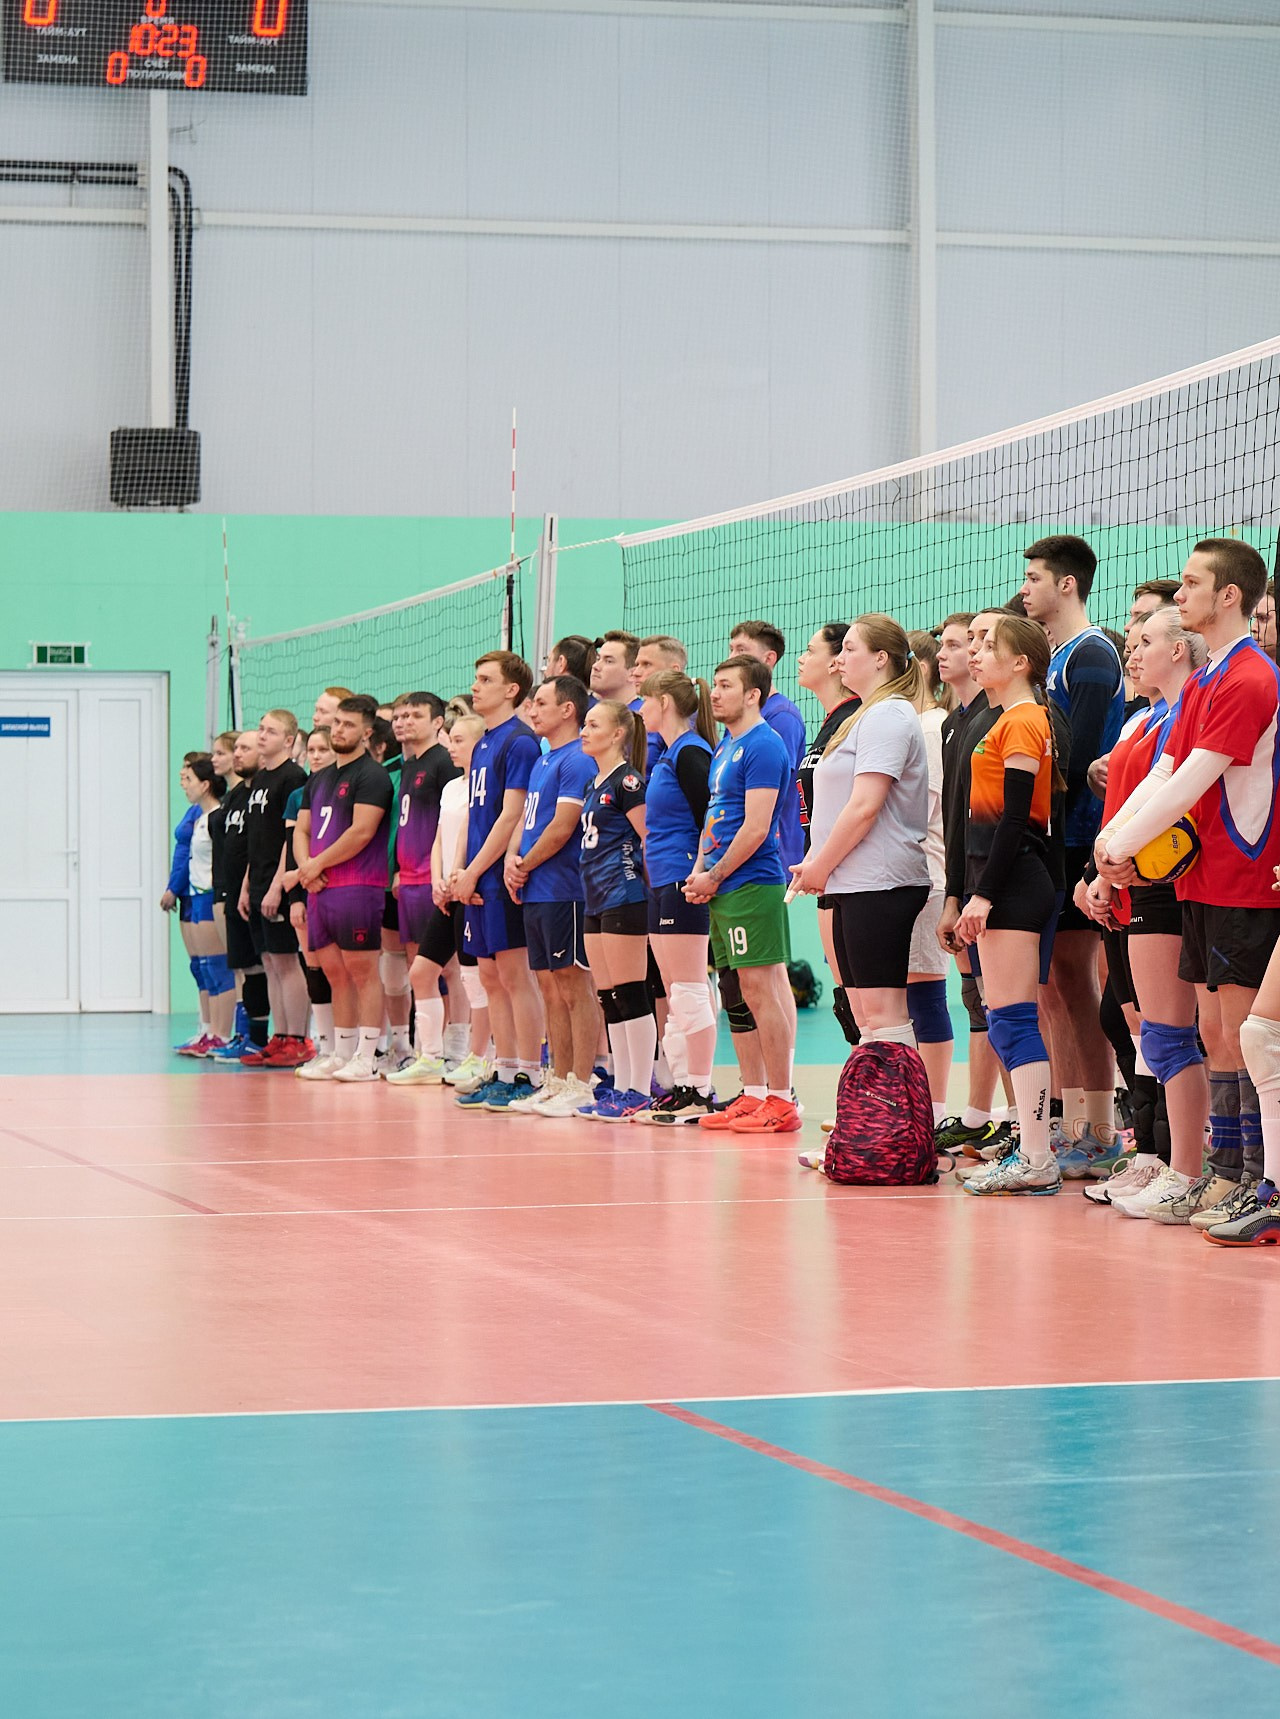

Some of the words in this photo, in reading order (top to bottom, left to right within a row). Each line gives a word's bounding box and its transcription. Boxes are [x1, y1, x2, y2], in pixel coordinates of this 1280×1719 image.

[129, 23, 198, 57] 10:23
[106, 51, 129, 84] 0
[184, 55, 207, 87] 0
[317, 806, 333, 839] 7
[399, 794, 411, 827] 9
[728, 926, 748, 956] 19
